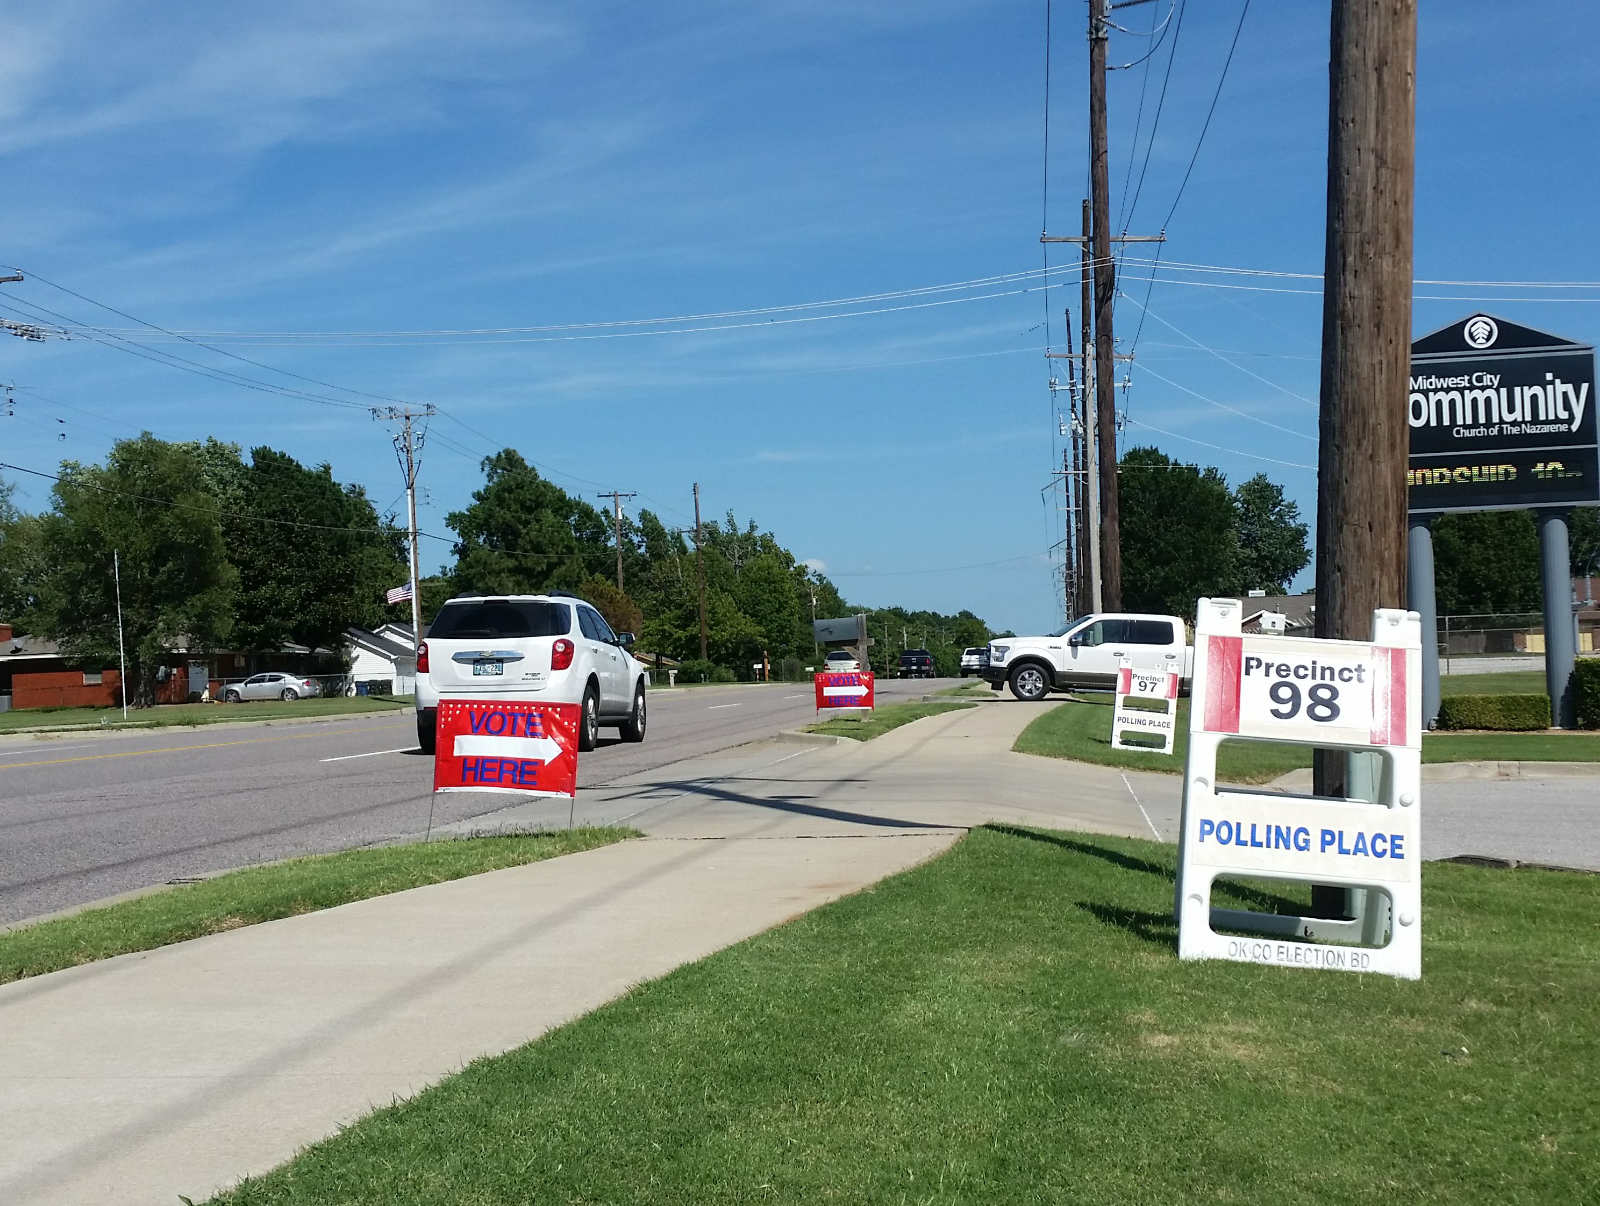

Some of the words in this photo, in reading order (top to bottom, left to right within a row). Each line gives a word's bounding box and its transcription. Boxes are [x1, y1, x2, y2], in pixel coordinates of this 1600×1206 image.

[1409, 375, 1470, 390] Midwest
[1472, 371, 1501, 388] City
[1409, 372, 1589, 432] ommunity
[1453, 425, 1488, 438] Church
[1488, 424, 1500, 436] of
[1502, 422, 1521, 435] The
[1521, 423, 1569, 434] Nazarene
[1132, 673, 1165, 683] Precinct
[1244, 656, 1366, 684] Precinct
[1138, 681, 1158, 692] 97
[1269, 681, 1341, 722] 98
[469, 710, 544, 737] VOTE
[1117, 716, 1147, 726] POLLING
[1148, 720, 1171, 728] PLACE
[462, 757, 539, 785] HERE
[1199, 818, 1311, 852] POLLING
[1320, 828, 1405, 859] PLACE
[1276, 946, 1346, 968] ELECTION
[1350, 952, 1371, 969] BD
